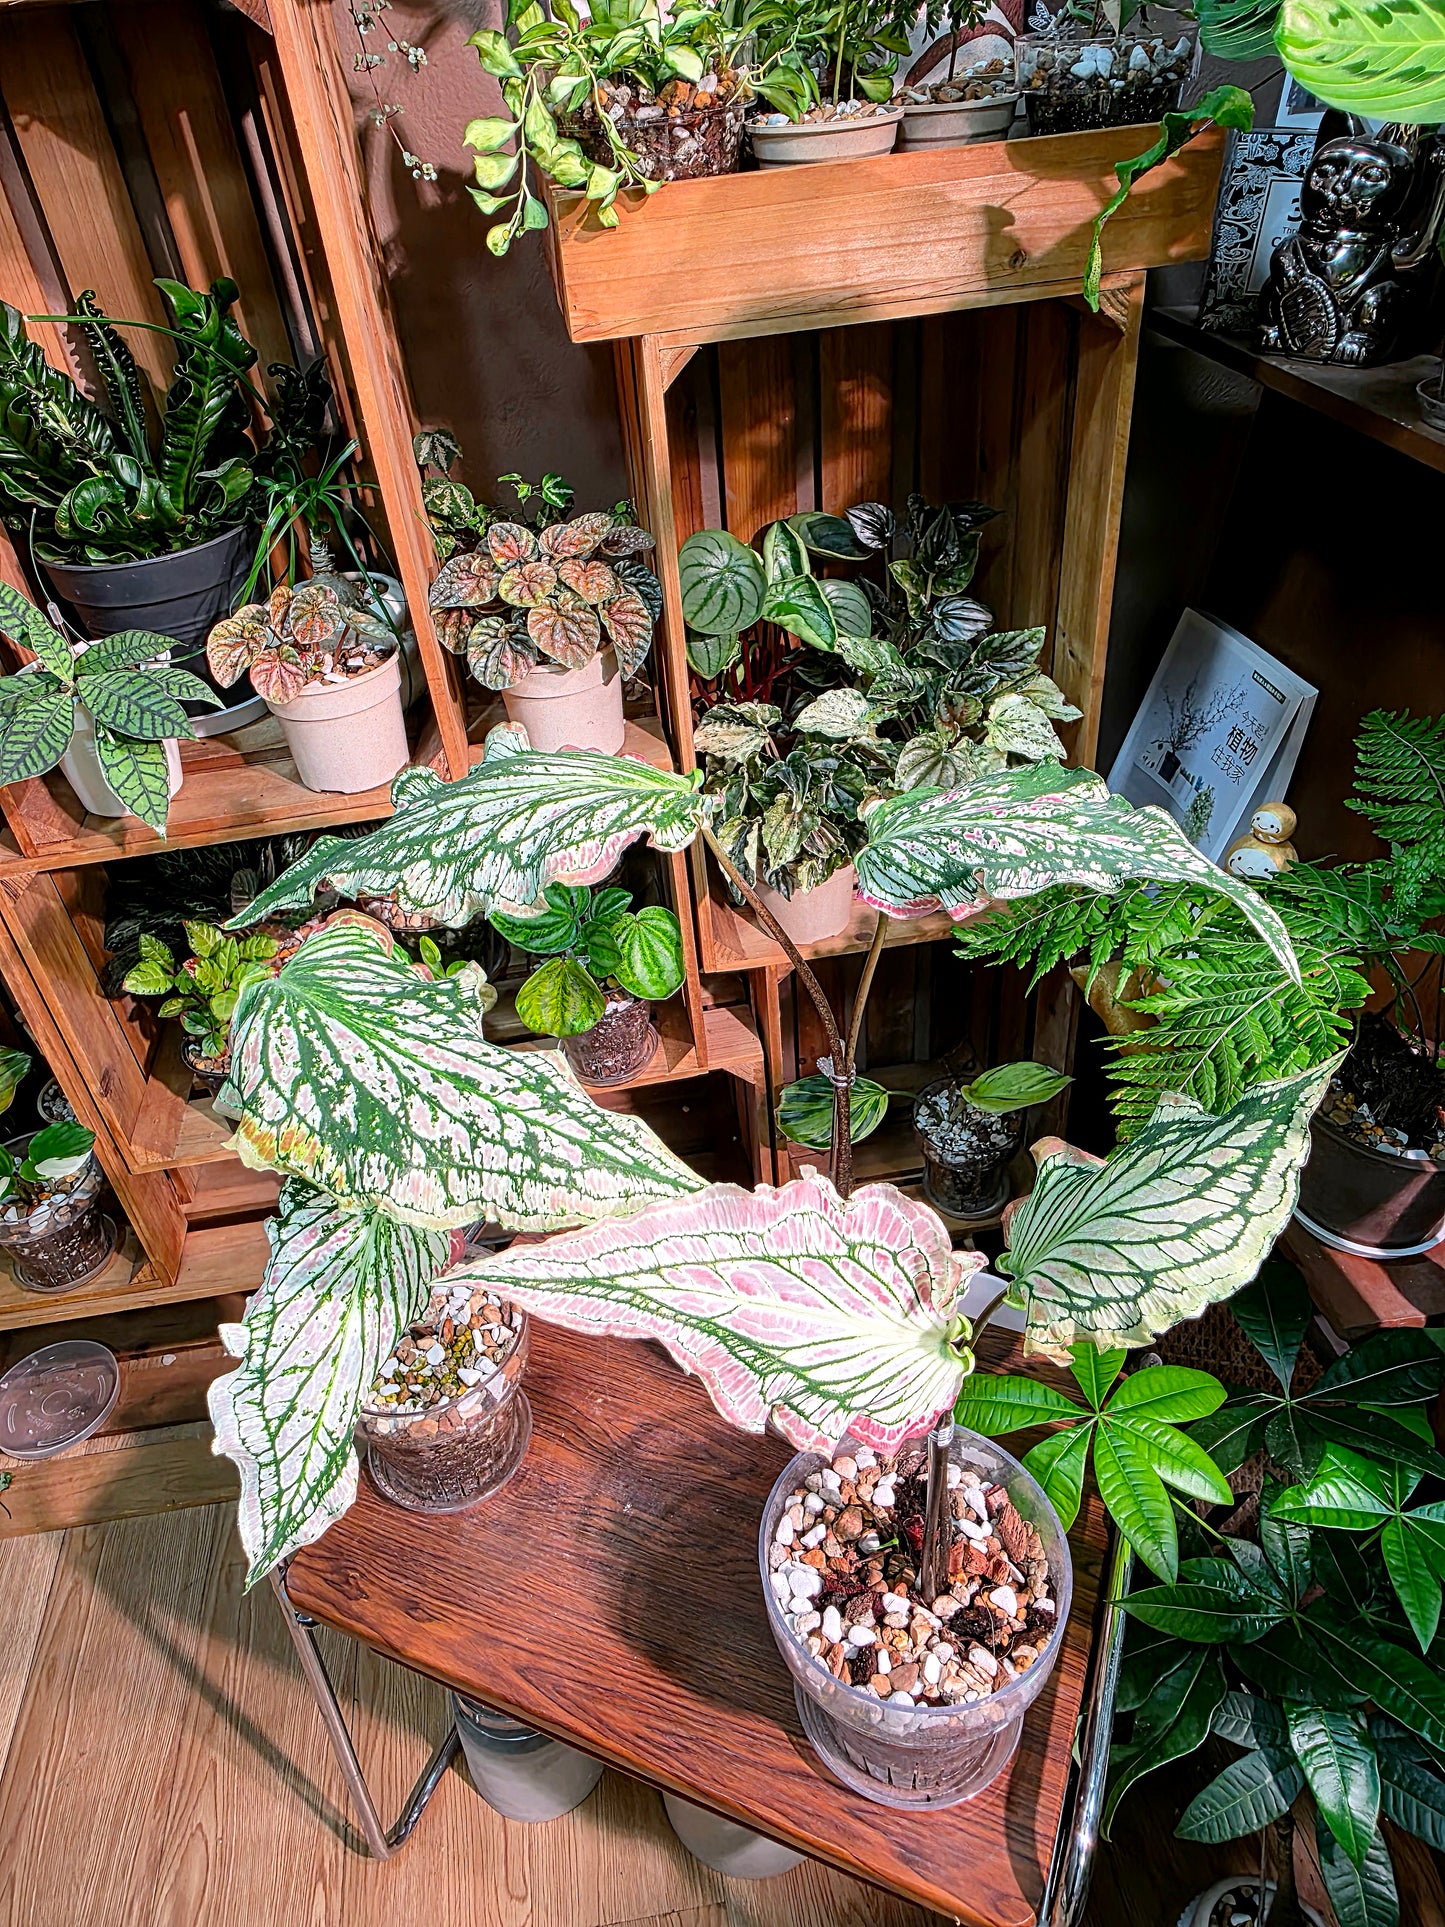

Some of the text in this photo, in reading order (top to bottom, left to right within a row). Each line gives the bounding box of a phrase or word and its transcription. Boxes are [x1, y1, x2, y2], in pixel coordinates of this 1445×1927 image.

[1211, 744, 1245, 786] 住我家
[1226, 723, 1258, 766] 植物
